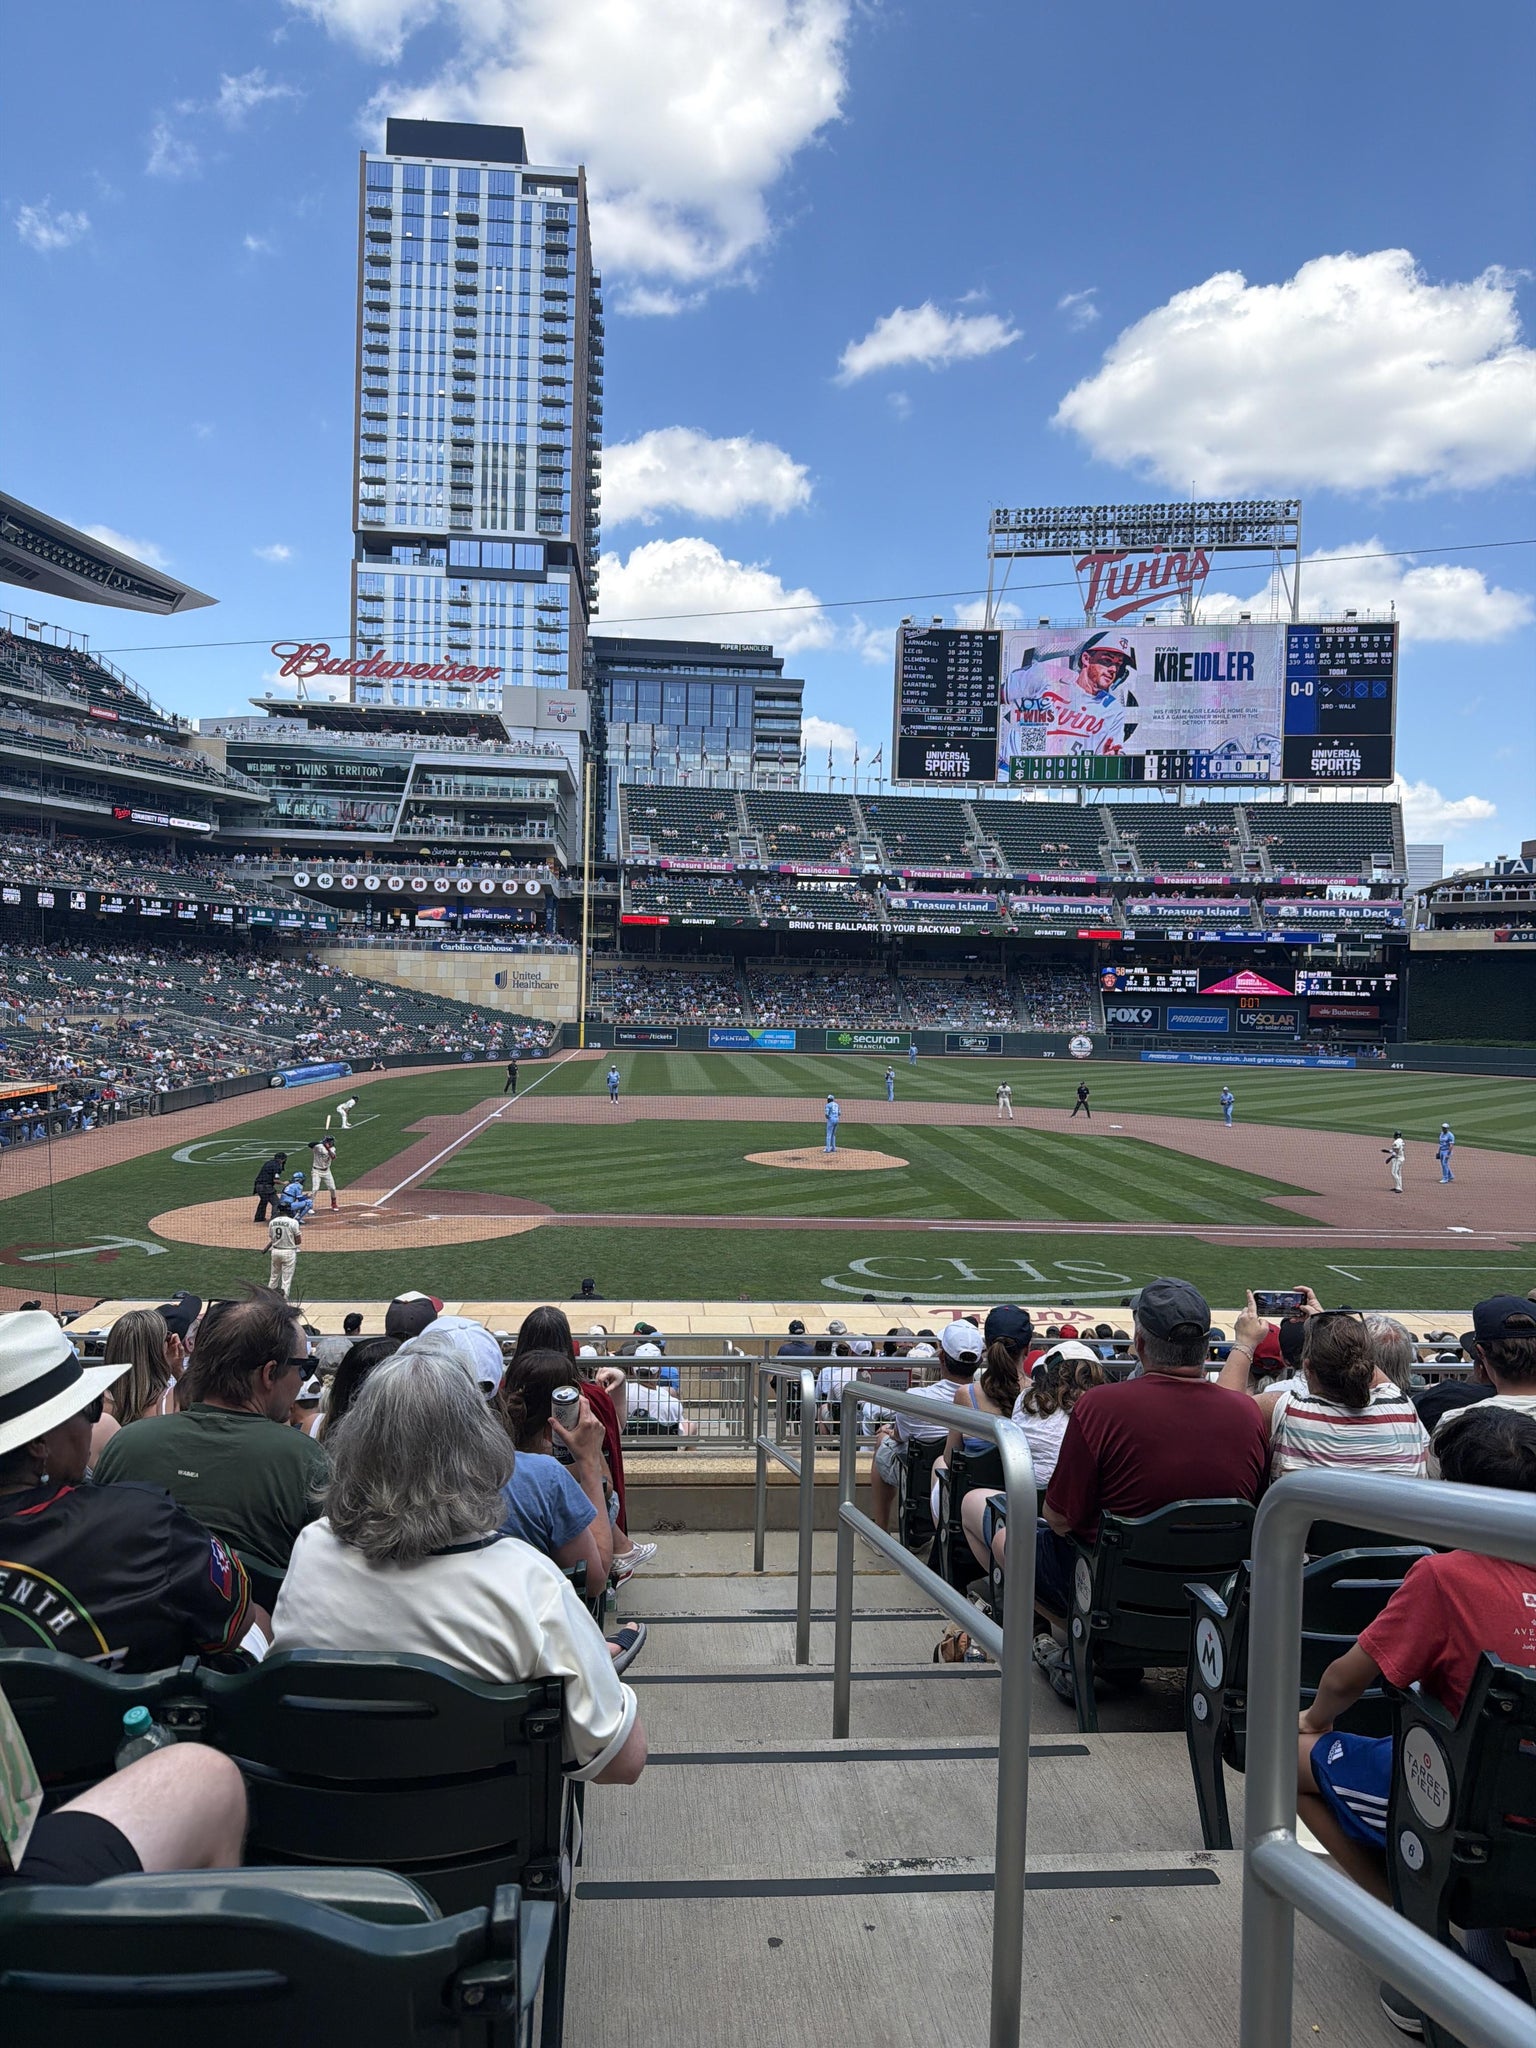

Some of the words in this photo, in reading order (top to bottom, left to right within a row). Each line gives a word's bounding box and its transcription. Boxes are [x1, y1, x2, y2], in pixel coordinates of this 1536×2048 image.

[1076, 545, 1210, 621] Twins
[741, 644, 769, 652] SANDLER
[271, 642, 501, 683] Budweiser
[1153, 651, 1255, 682] KREIDLER
[1290, 681, 1314, 696] 0-0
[1014, 709, 1055, 723] TWINS
[926, 750, 970, 760] UNIVERSAL
[1312, 749, 1361, 758] UNIVERSAL
[925, 760, 970, 772] SPORTS
[1034, 759, 1039, 767] 1
[1046, 758, 1052, 767] 0
[1058, 758, 1064, 767] 0
[1071, 758, 1077, 767] 0
[1084, 758, 1090, 767] 0
[1215, 761, 1222, 771] 0
[1235, 761, 1242, 771] 0
[1256, 761, 1261, 771] 1
[1311, 758, 1361, 770] SPORTS
[246, 762, 276, 772] WELCOME
[296, 763, 328, 777] TWINS
[334, 764, 385, 777] TERRITORY
[1033, 770, 1039, 779] 0
[1045, 770, 1051, 779] 0
[1058, 770, 1064, 779] 0
[1071, 770, 1077, 779] 0
[1085, 770, 1089, 778] 1
[278, 803, 291, 815] WE
[294, 803, 310, 816] ARE
[310, 804, 326, 816] ALL
[131, 812, 157, 822] COMMUNITY
[157, 816, 168, 824] FUND
[1496, 859, 1536, 875] TA
[942, 871, 965, 879] Island
[344, 878, 354, 886] 36
[369, 879, 375, 887] 7
[460, 882, 468, 890] 14
[1162, 877, 1197, 885] Treasure
[1199, 877, 1223, 885] Island
[70, 901, 86, 910] MLB
[912, 901, 956, 911] Treasure
[959, 902, 988, 911] Island
[1032, 904, 1061, 914] Home
[1063, 904, 1082, 914] Run
[1085, 905, 1109, 915] Deck
[1157, 906, 1204, 916] Treasure
[1207, 906, 1240, 916] Island
[1303, 907, 1337, 918] Home
[1339, 908, 1360, 917] Run
[1363, 908, 1391, 919] Deck
[789, 920, 815, 930] BRING
[816, 921, 833, 930] THE
[834, 922, 879, 932] BALLPARK
[880, 923, 892, 932] TO
[893, 924, 915, 933] YOUR
[916, 925, 961, 934] BACKYARD
[440, 943, 472, 951] Carbliss
[473, 943, 513, 952] Clubhouse
[512, 971, 541, 981] United
[1116, 967, 1125, 976] 58
[1298, 970, 1307, 979] 41
[512, 979, 559, 990] Healthcare
[1240, 997, 1260, 1008] 0:07
[1106, 1008, 1140, 1023] FOX
[1141, 1008, 1153, 1023] 9
[1331, 1008, 1370, 1016] Budweiser
[1170, 1014, 1226, 1024] PROGRESSIVE
[620, 1033, 673, 1041] twins.com/tickets
[852, 1035, 900, 1044] securian
[1256, 1057, 1274, 1065] great
[275, 1227, 283, 1240] 9
[848, 1256, 1133, 1285] CHS
[177, 1469, 199, 1478] WAIMEA
[1406, 1750, 1449, 1801] TARGET
[1410, 1769, 1442, 1807] FIELD
